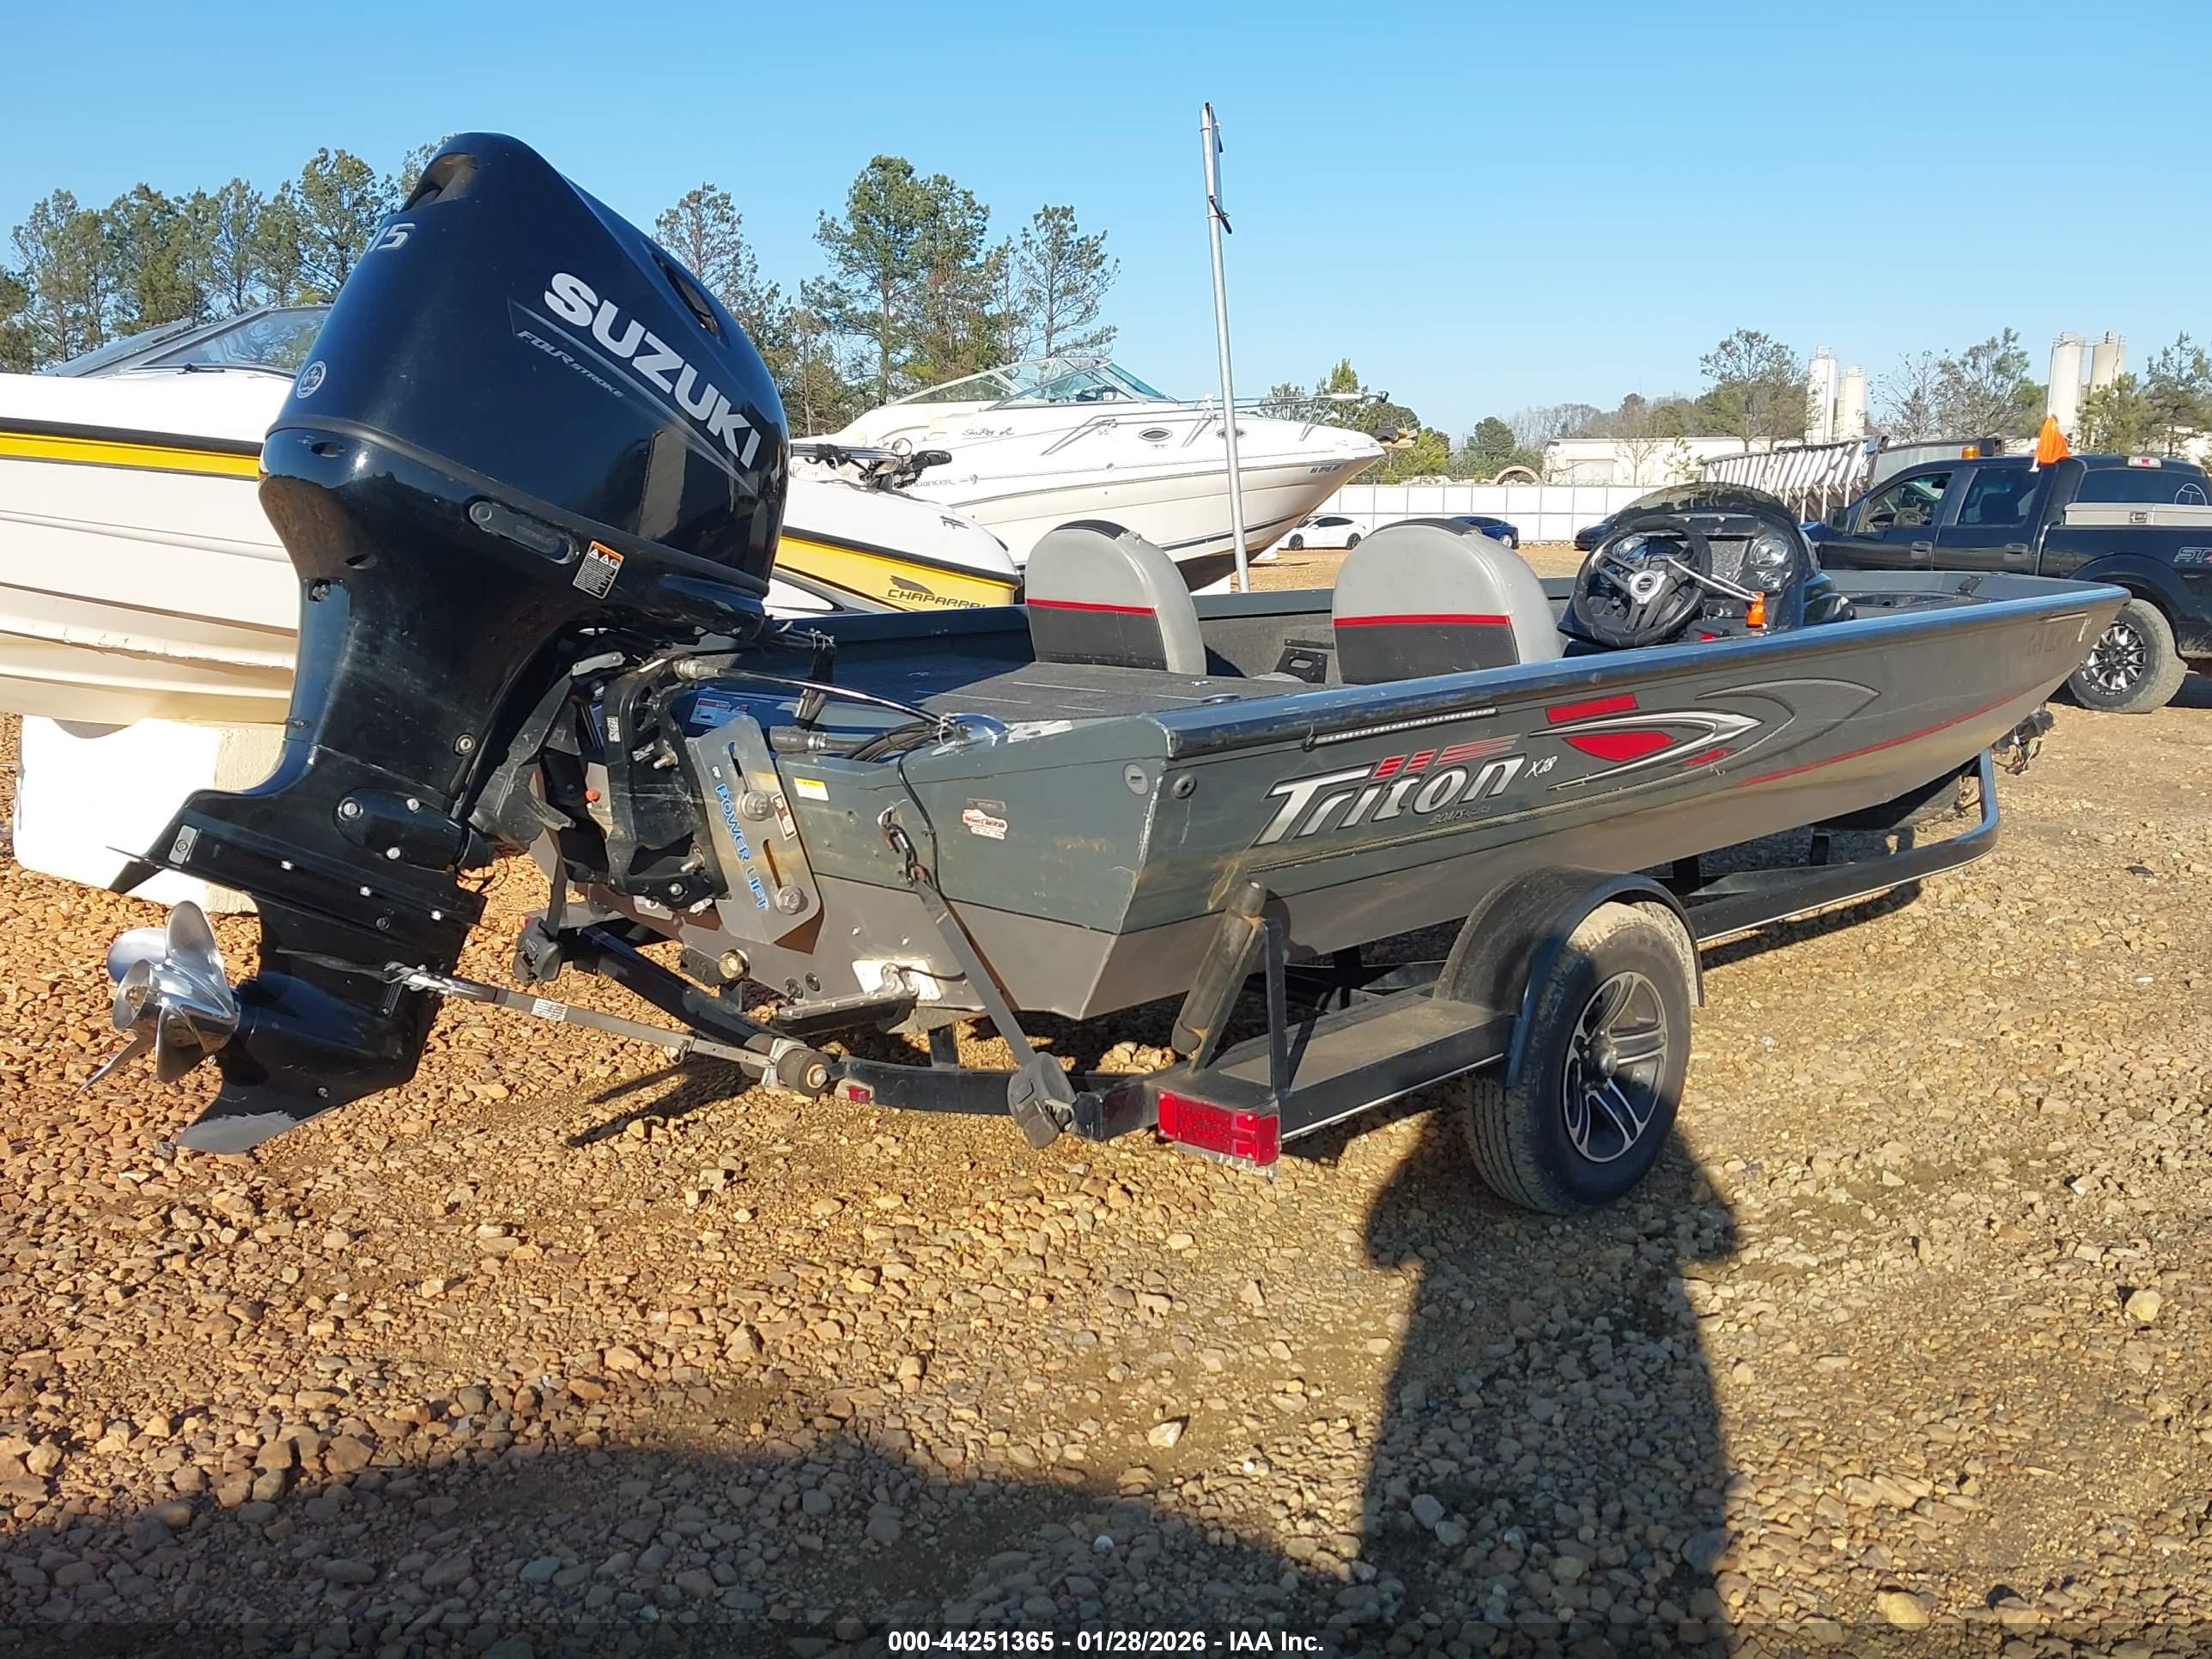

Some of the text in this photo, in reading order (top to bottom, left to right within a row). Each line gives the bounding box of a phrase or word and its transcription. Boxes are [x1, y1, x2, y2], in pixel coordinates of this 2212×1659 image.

[544, 272, 762, 470] SUZUKI
[714, 782, 770, 910] POWER LIFT
[1252, 753, 1559, 847] Triton X18
